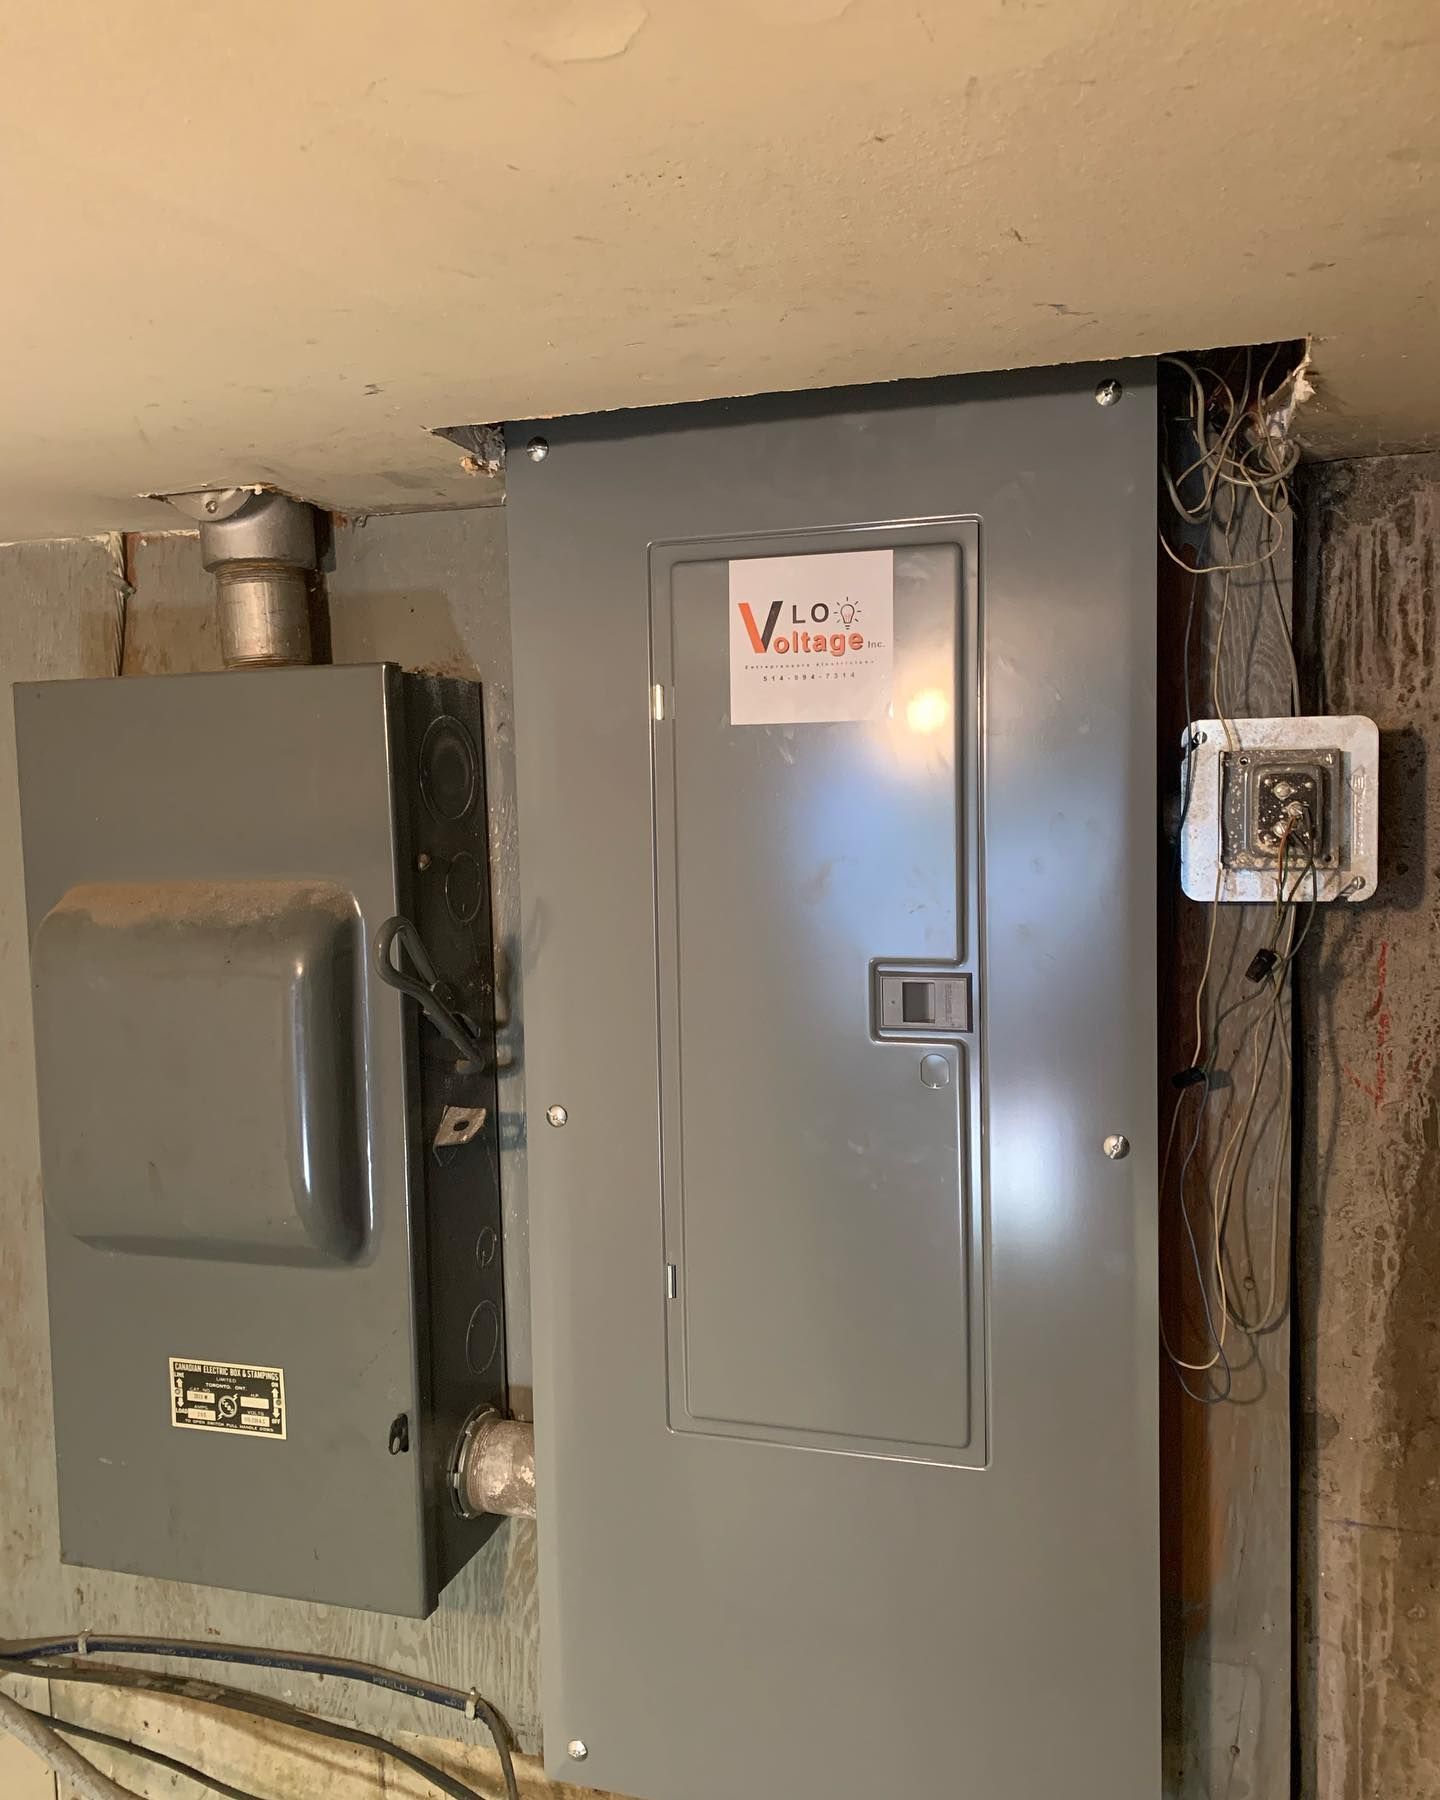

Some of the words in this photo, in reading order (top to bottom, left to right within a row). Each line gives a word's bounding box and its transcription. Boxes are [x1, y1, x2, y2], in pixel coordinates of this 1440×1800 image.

[738, 600, 864, 657] Voltage
[867, 640, 885, 649] Inc.
[174, 1362, 201, 1373] CANADIAN
[203, 1366, 229, 1376] ELECTRIC
[230, 1368, 241, 1377] BOX
[242, 1369, 247, 1377] &
[247, 1369, 279, 1381] STAMPINGS
